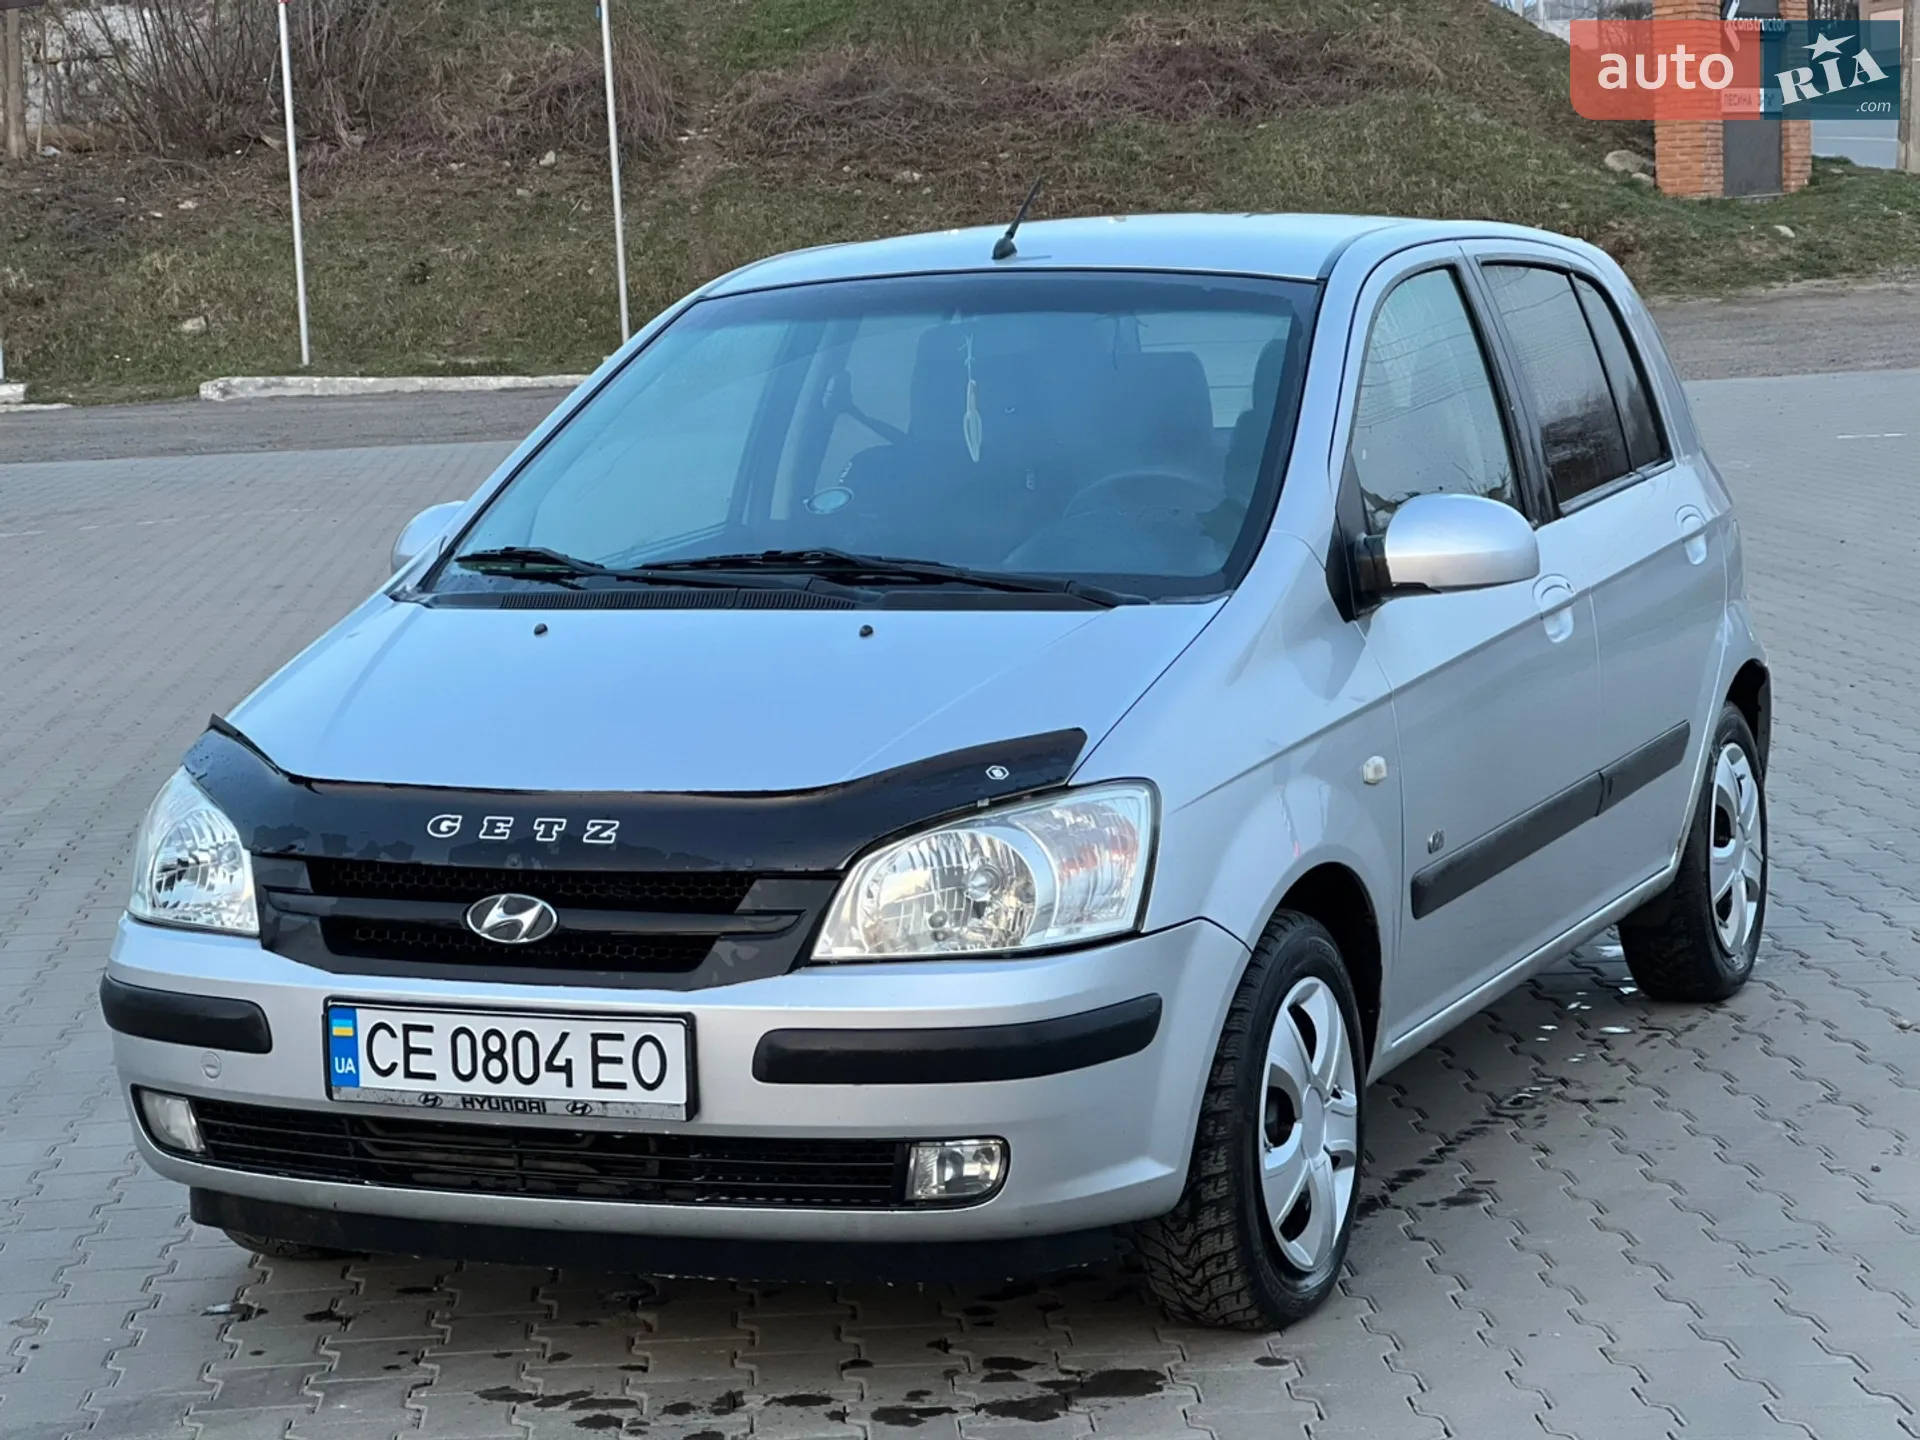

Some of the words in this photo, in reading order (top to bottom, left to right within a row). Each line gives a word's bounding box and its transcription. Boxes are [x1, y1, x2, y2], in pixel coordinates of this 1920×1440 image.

[426, 813, 620, 844] GETZ
[334, 1056, 356, 1075] UA
[365, 1021, 437, 1081] CE
[450, 1026, 574, 1088] 0804
[590, 1032, 667, 1091] EO
[461, 1096, 547, 1113] HYUNDAI
